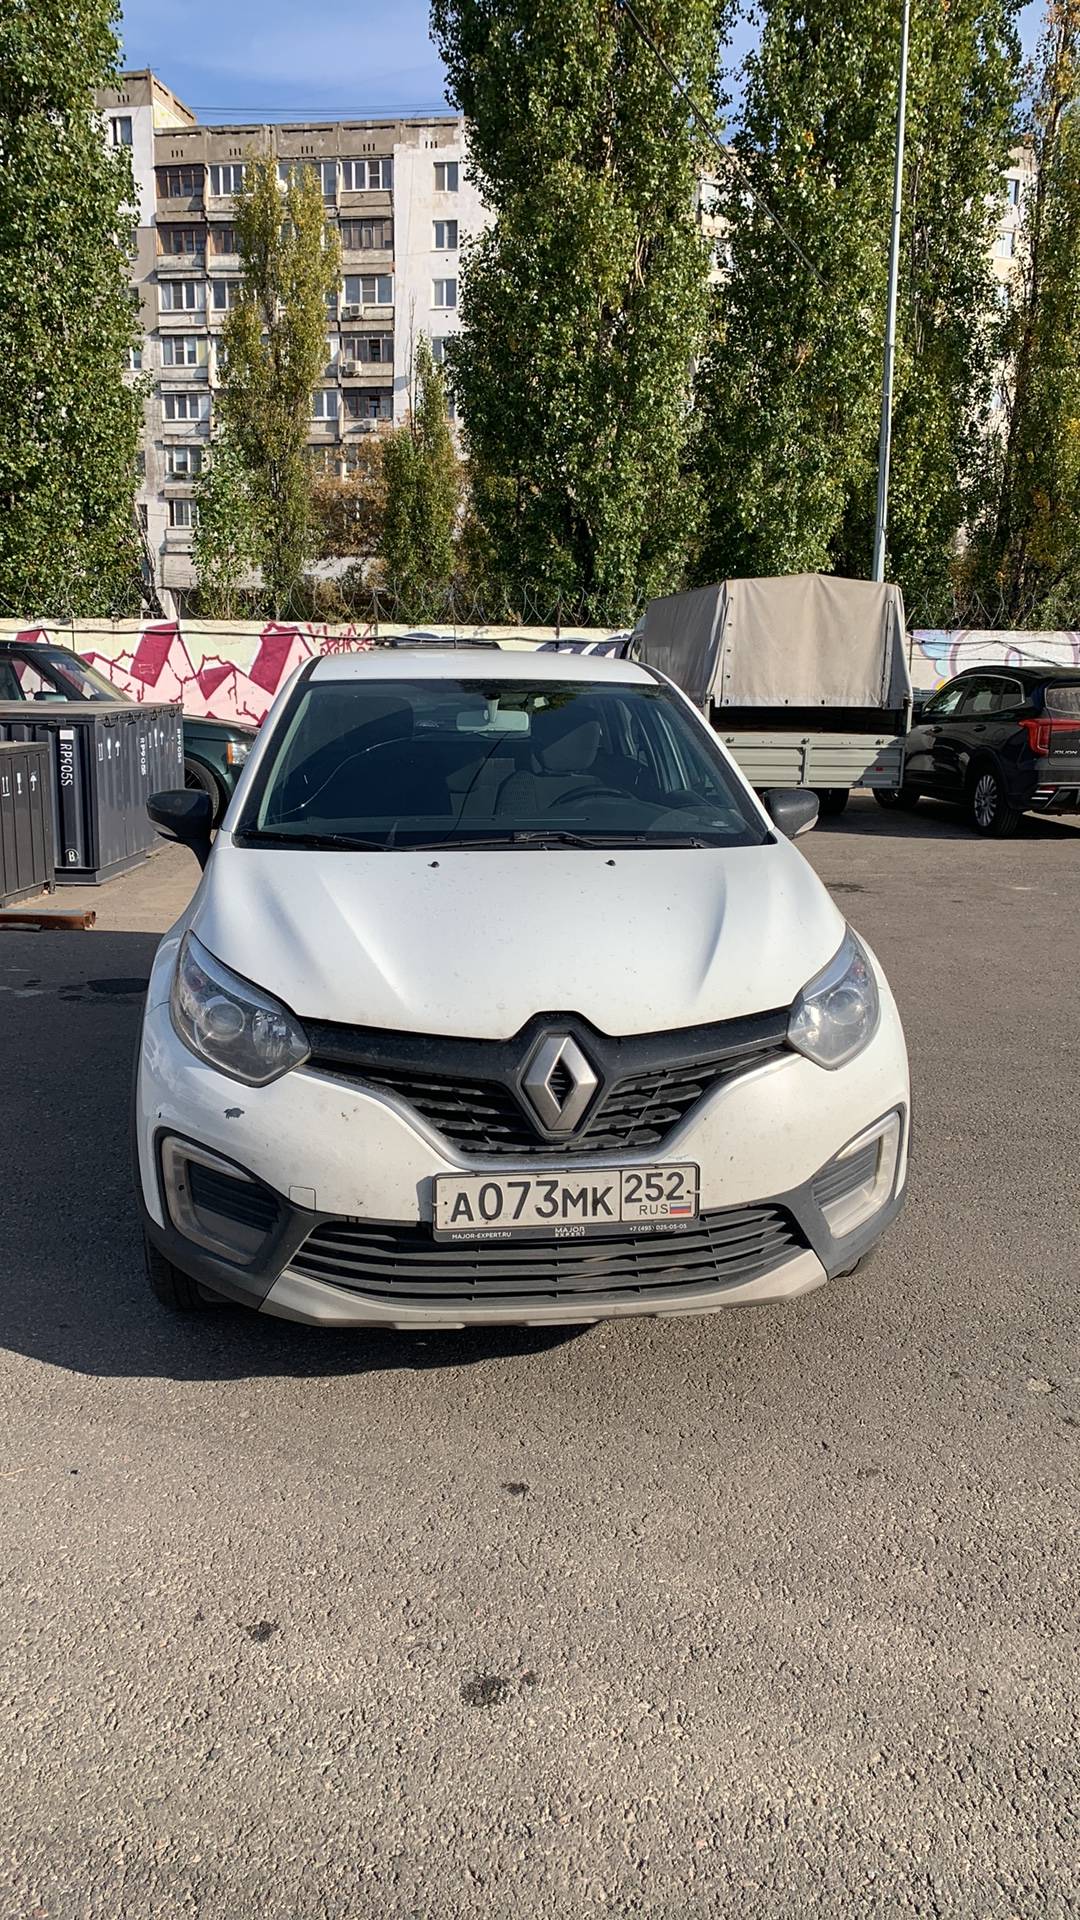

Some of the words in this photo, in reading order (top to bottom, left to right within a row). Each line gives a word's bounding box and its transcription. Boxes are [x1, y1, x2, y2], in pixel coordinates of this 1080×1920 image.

[60, 743, 73, 786] RP905S
[450, 1179, 615, 1223] А073МК
[624, 1171, 685, 1203] 252
[639, 1204, 669, 1215] RUS
[452, 1231, 512, 1240] MAJOR-EXPERT.RU
